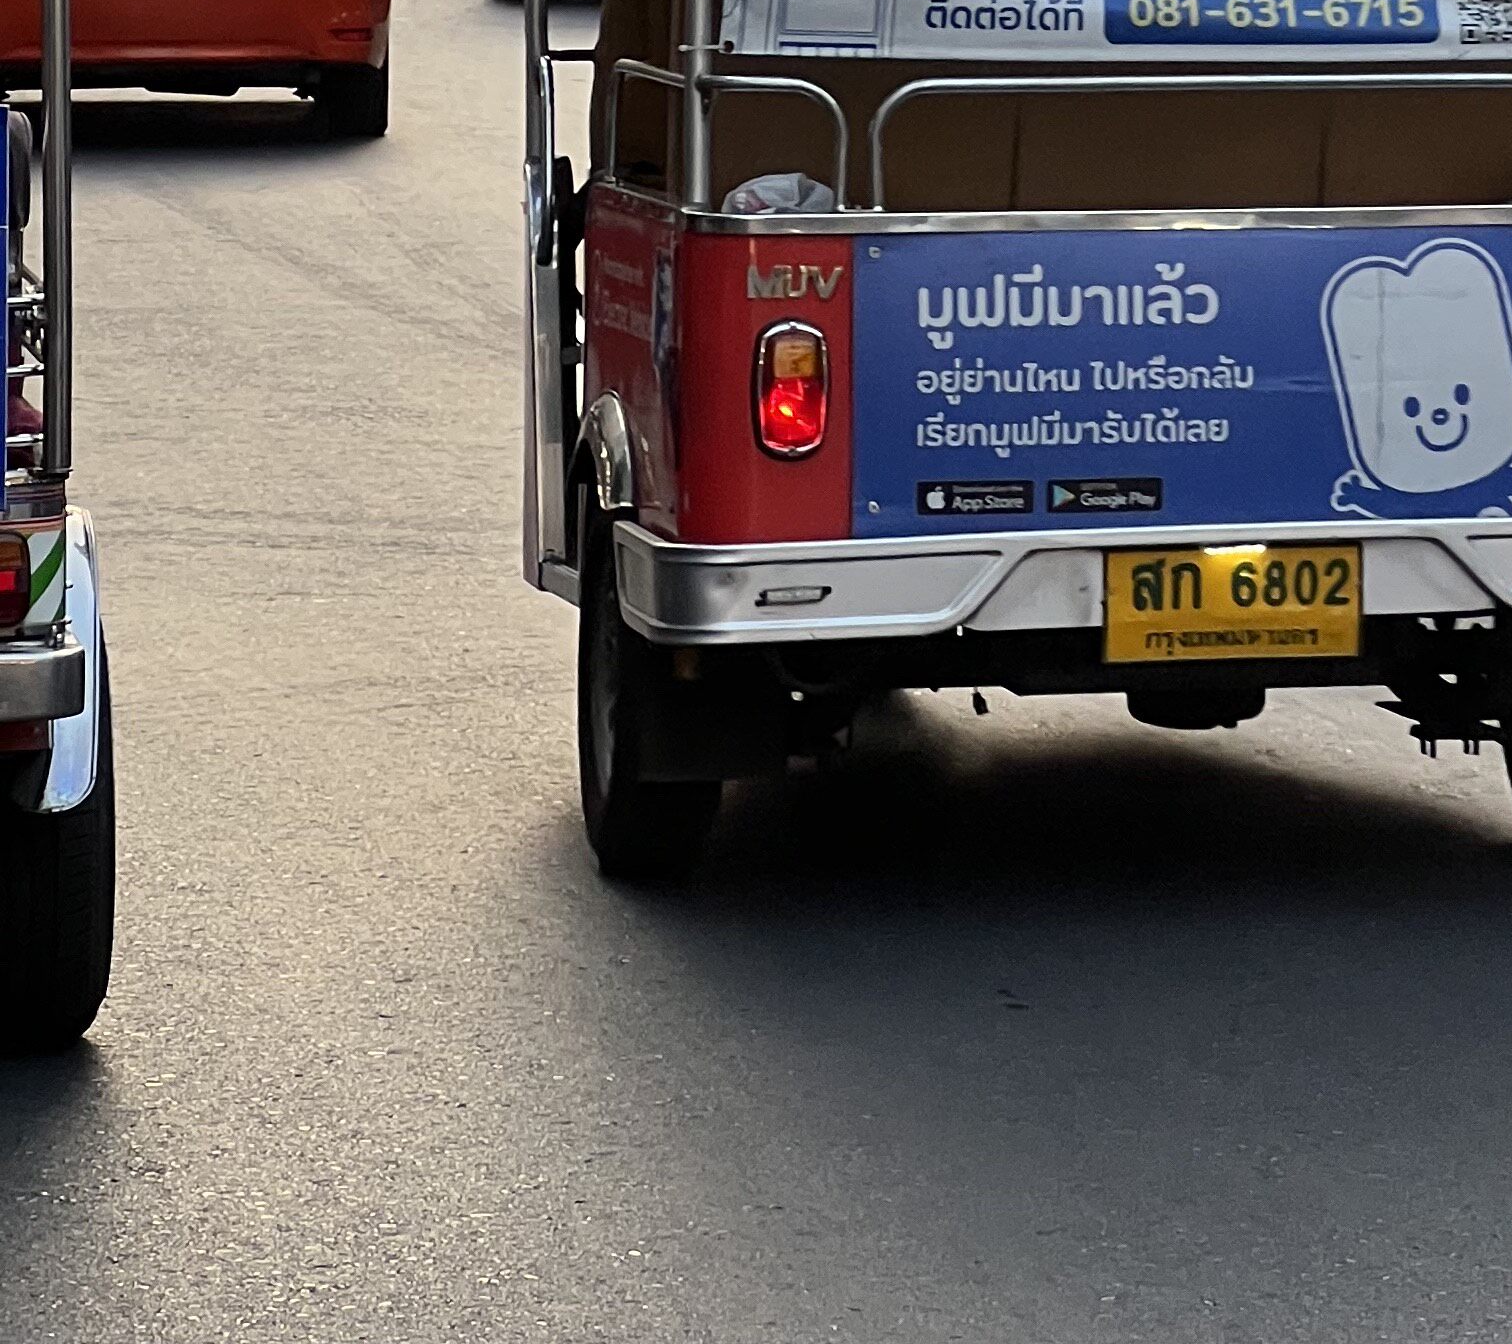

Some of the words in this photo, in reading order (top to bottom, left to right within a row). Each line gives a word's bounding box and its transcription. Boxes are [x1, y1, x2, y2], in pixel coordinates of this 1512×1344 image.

[917, 262, 1221, 350] มูฟมีมาแล้ว
[916, 355, 1081, 406] อยู่ย่านไหน
[1090, 354, 1255, 391] ไปหรือกลับ
[916, 408, 1230, 459] เรียกมูฟมีมารับได้เลย
[952, 496, 984, 511] App
[1131, 558, 1203, 612] สก
[1230, 558, 1351, 608] 6802
